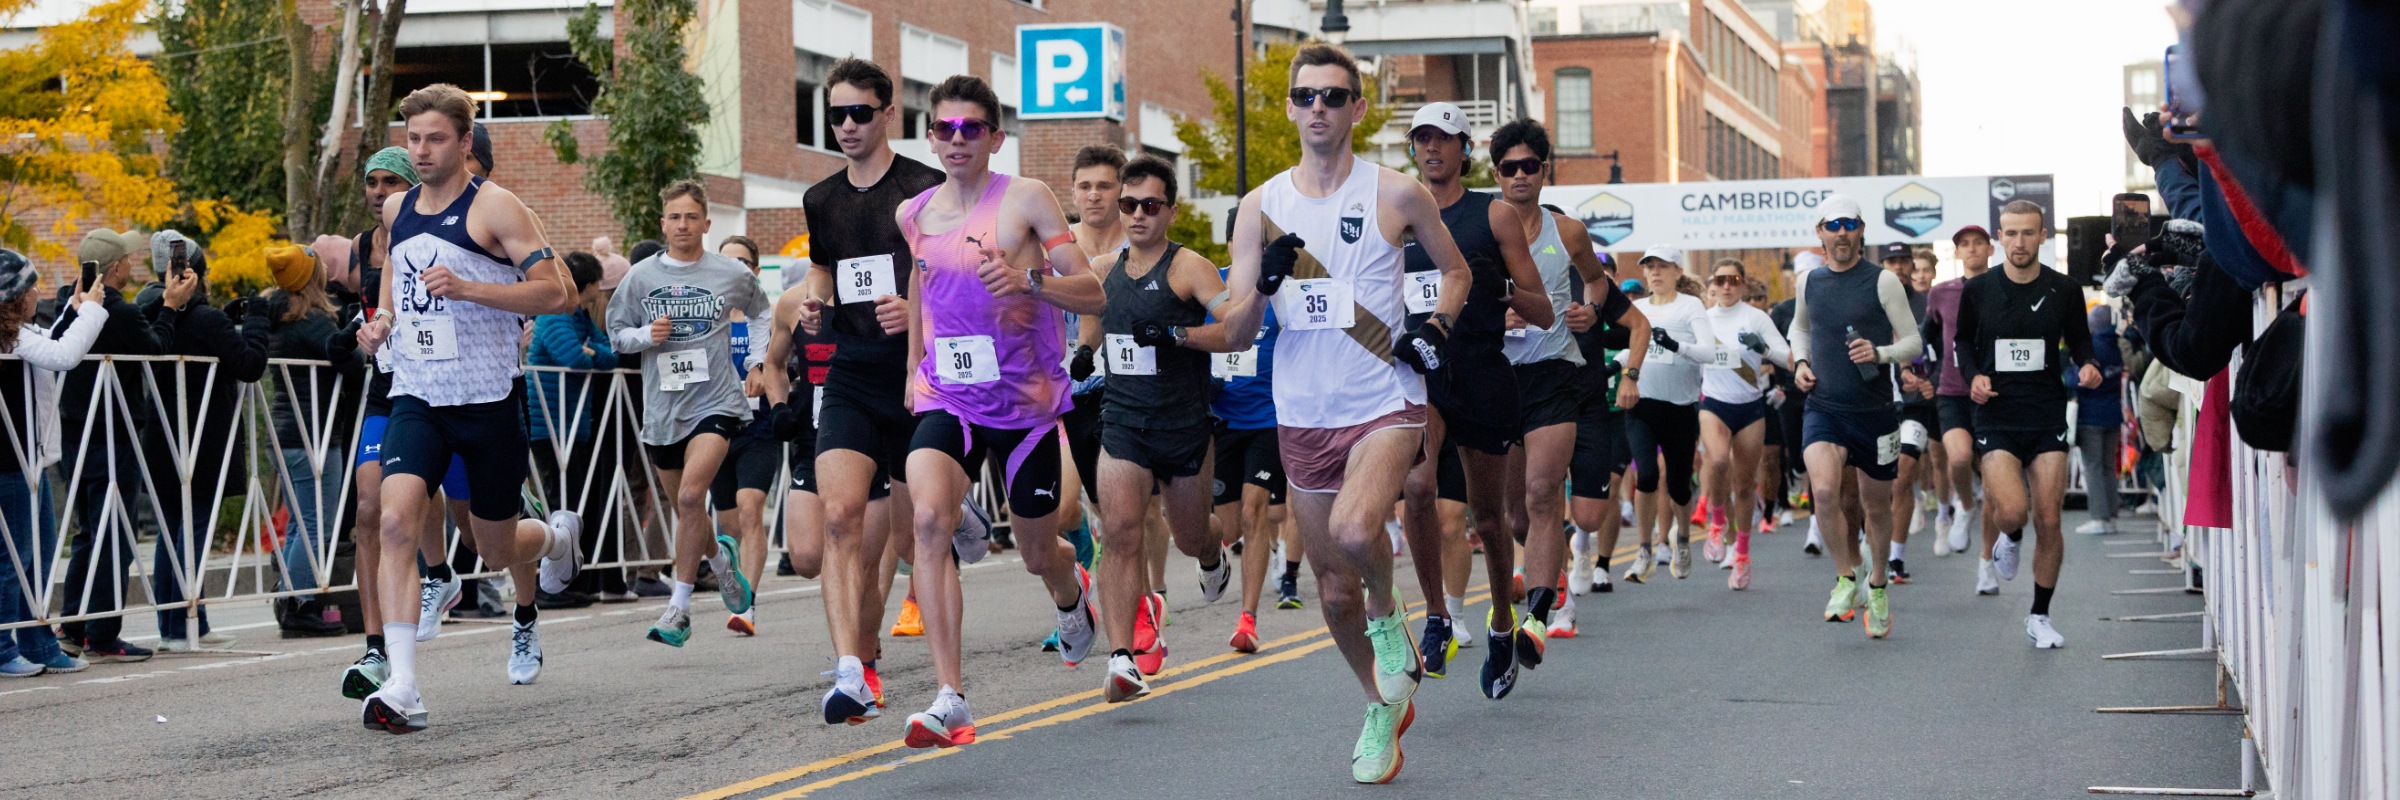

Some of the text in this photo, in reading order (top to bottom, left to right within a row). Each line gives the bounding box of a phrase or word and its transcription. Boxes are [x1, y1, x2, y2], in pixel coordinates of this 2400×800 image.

[1036, 39, 1088, 107] P
[1681, 190, 1834, 212] CAMBRIDGE
[1682, 213, 1807, 226] HALF MARATHON
[1709, 228, 1815, 240] CAMBRIDGES
[855, 270, 873, 288] 38
[1422, 283, 1438, 299] 61
[641, 294, 725, 322] CHAMPIONS
[1305, 294, 1328, 314] 35
[1309, 315, 1327, 323] 2025
[417, 330, 433, 346] 45
[420, 347, 434, 355] 2025
[1120, 347, 1133, 362] 41
[1715, 352, 1728, 361] 112
[2010, 349, 2030, 361] 129
[953, 351, 972, 370] 30
[1226, 353, 1240, 366] 42
[671, 360, 694, 374] 344
[957, 371, 973, 379] 2025
